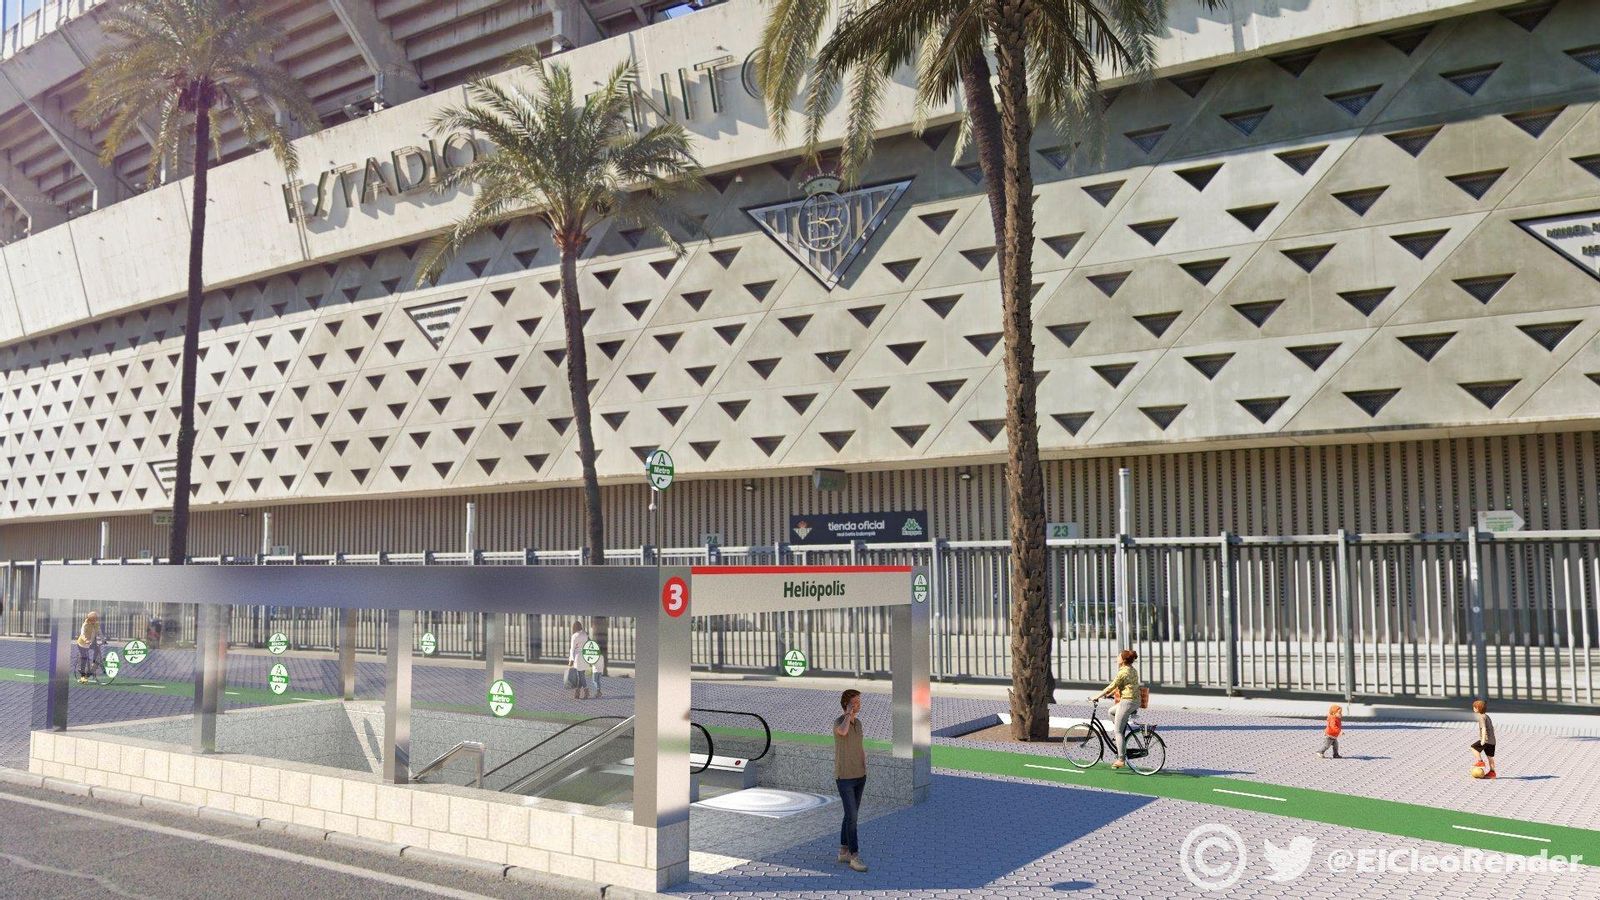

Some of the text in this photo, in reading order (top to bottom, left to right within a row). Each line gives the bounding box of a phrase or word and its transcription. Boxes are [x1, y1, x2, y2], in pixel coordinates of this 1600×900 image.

[282, 131, 479, 224] ESTADIO
[653, 466, 671, 475] Metro
[828, 520, 885, 532] tienda oficial
[1053, 525, 1069, 537] 23
[706, 536, 718, 545] 24
[668, 583, 683, 611] 3
[783, 580, 846, 602] Heliópolis
[492, 694, 511, 703] Metro
